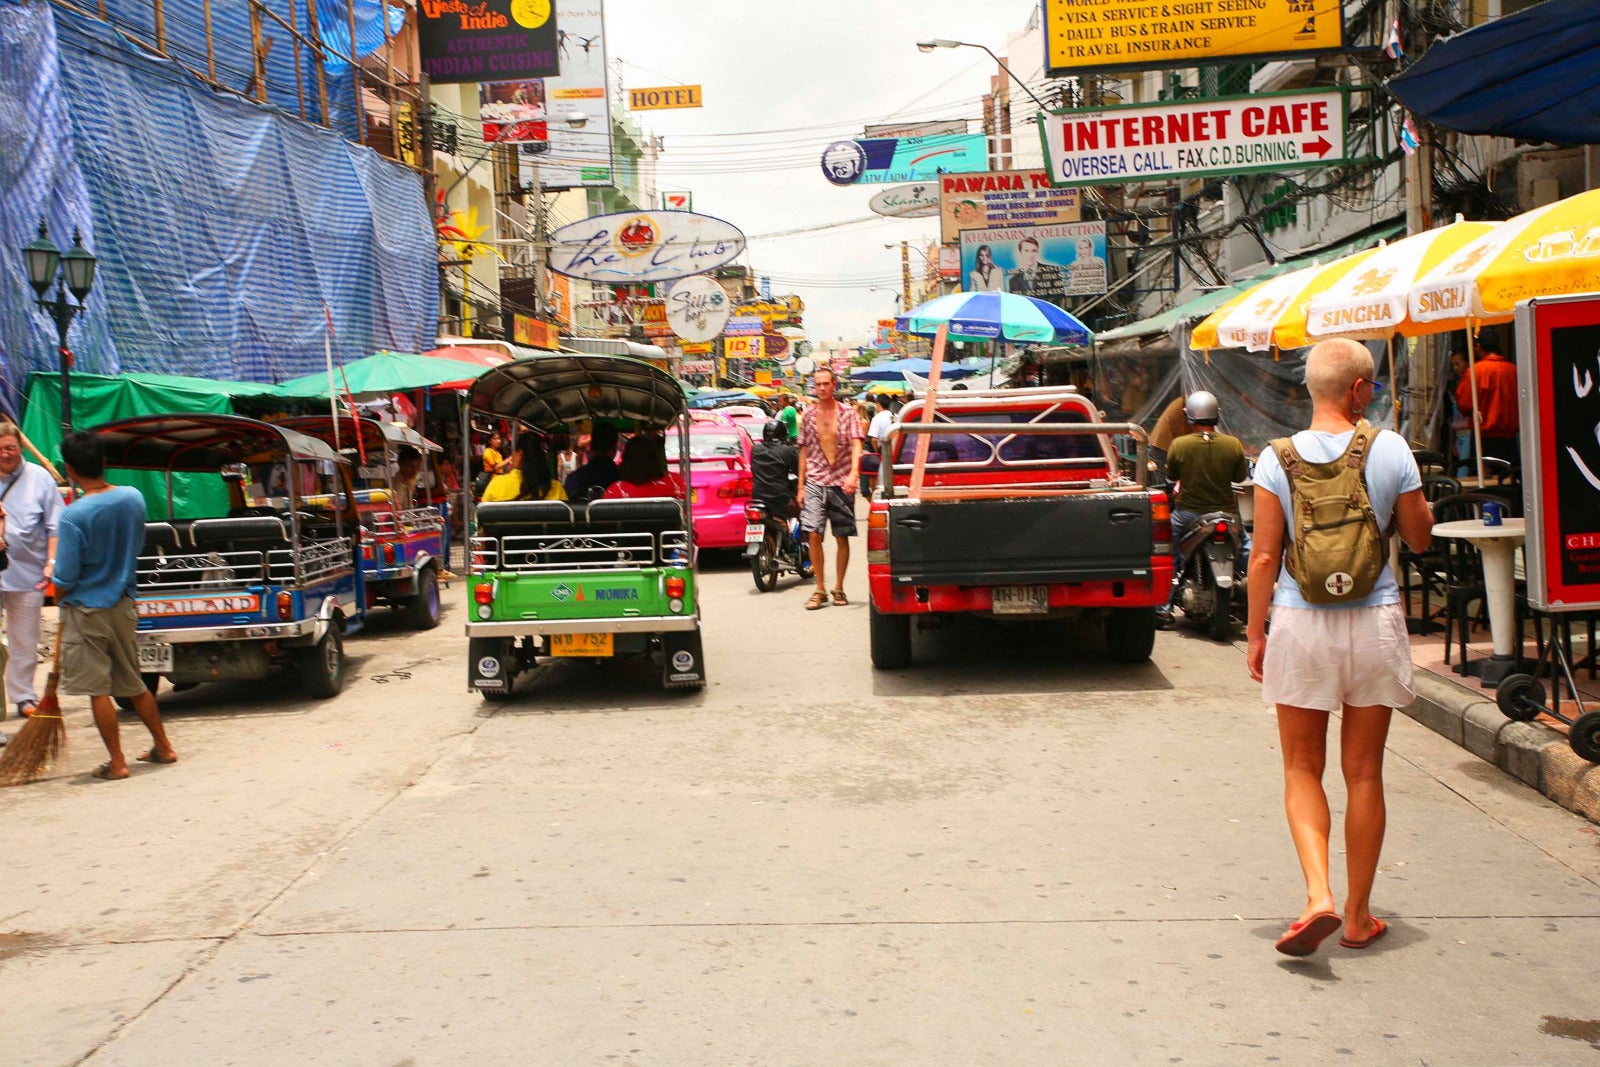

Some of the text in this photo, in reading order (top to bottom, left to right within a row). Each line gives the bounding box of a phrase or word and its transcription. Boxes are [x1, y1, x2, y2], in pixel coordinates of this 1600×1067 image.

[421, 0, 487, 18] Taste of
[1067, 0, 1266, 24] VISA SERVICE & SIGHT SEEING
[1289, 4, 1315, 13] IATA
[460, 11, 509, 30] India
[1067, 16, 1256, 40] DAILY BUS & TRAIN SERVICE
[447, 34, 529, 53] AUTHENTIC
[1068, 37, 1211, 57] TRAVEL INSURANCE
[425, 50, 554, 75] INDIAN CUISINE
[632, 89, 699, 107] HOTEL
[1063, 101, 1328, 152] INTERNET CAFE
[1062, 154, 1127, 178] OVERSEA
[943, 175, 1025, 193] PAWANA
[1035, 189, 1047, 198] AIR
[1048, 188, 1077, 197] TICKETS
[1045, 199, 1075, 208] SERVICE
[987, 211, 1057, 221] HOTEL RESERVATION
[964, 224, 1104, 244] KHAOSARN COLLECTION
[561, 230, 734, 270] The Club
[672, 291, 707, 313] Silk
[1322, 303, 1392, 328] SINGHA
[1567, 536, 1600, 547] CH
[595, 588, 638, 601] MONIKA
[137, 598, 251, 614] HAILAND
